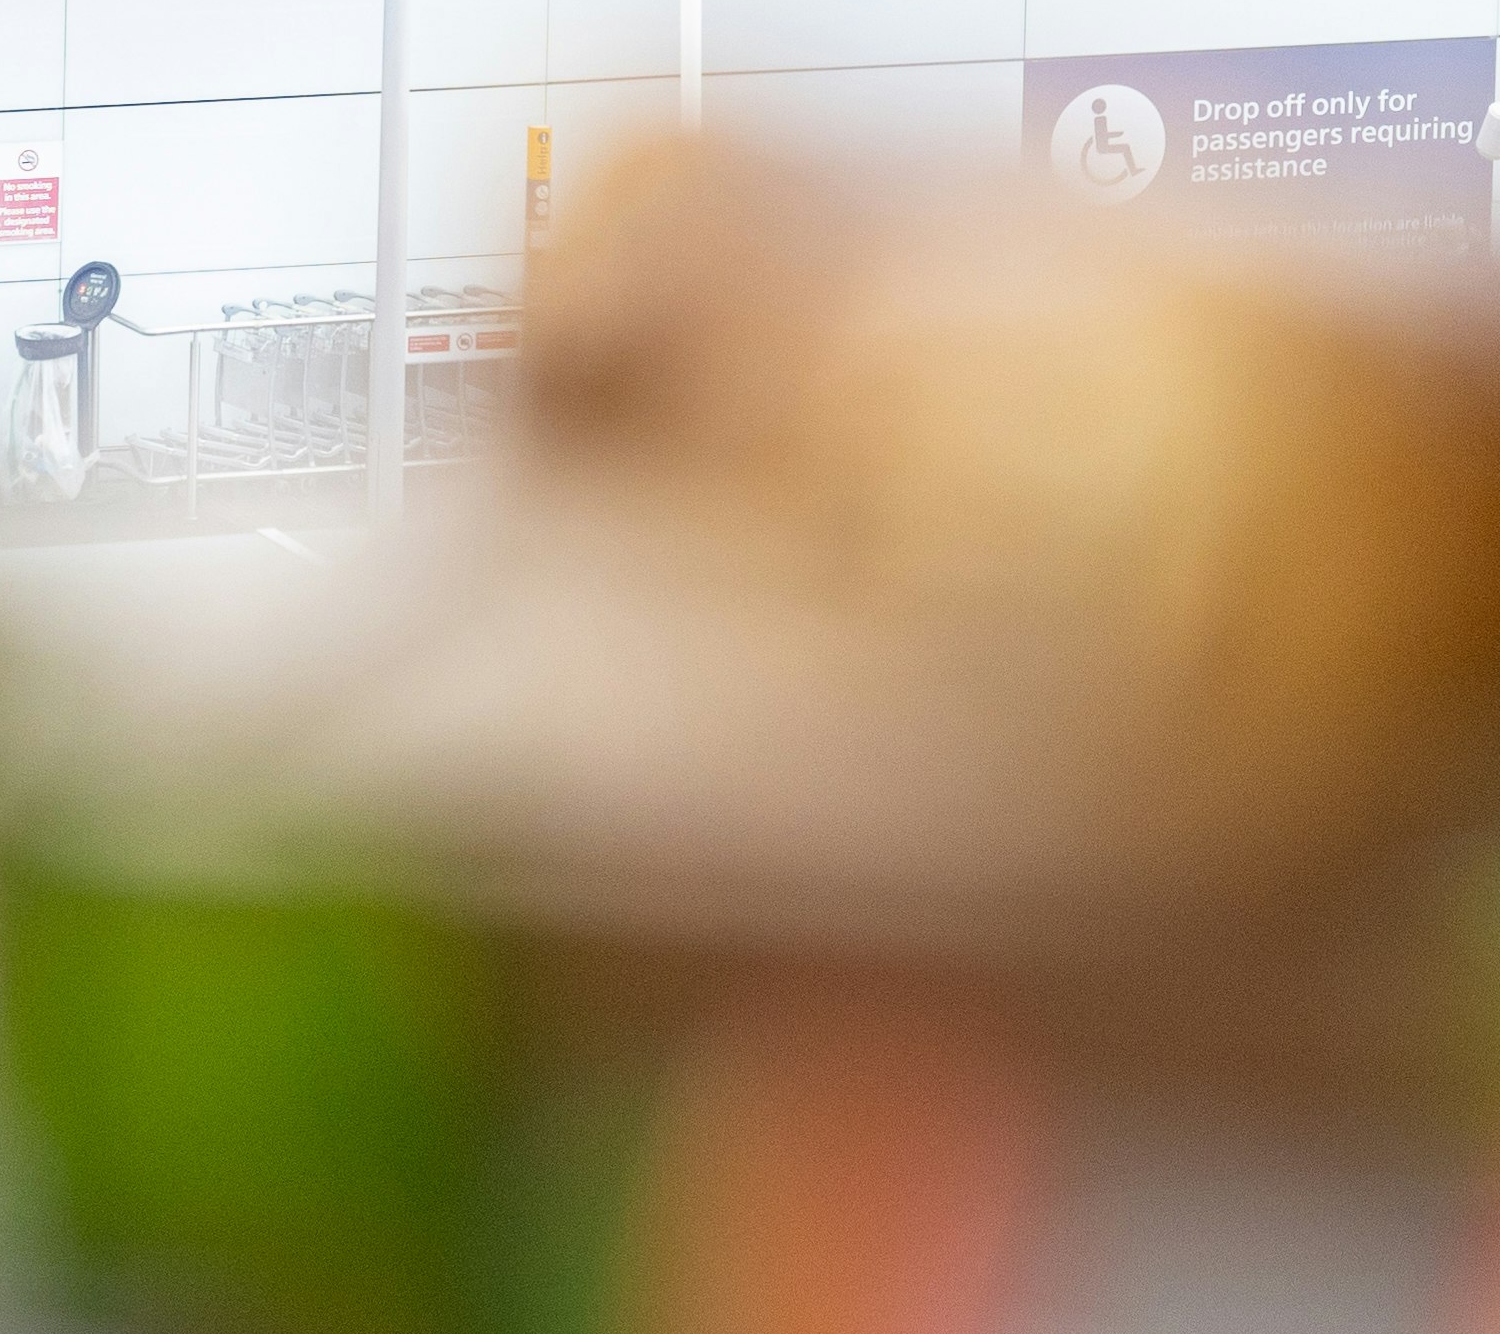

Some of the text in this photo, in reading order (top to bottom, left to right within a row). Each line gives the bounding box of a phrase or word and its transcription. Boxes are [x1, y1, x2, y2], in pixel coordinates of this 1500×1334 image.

[1194, 89, 1417, 125] Drop off only for
[1192, 117, 1474, 157] passengers requiring
[1191, 157, 1328, 182] assistance
[3, 181, 53, 191] No smoking
[4, 194, 13, 202] in
[14, 193, 29, 201] this
[1399, 217, 1420, 230] are
